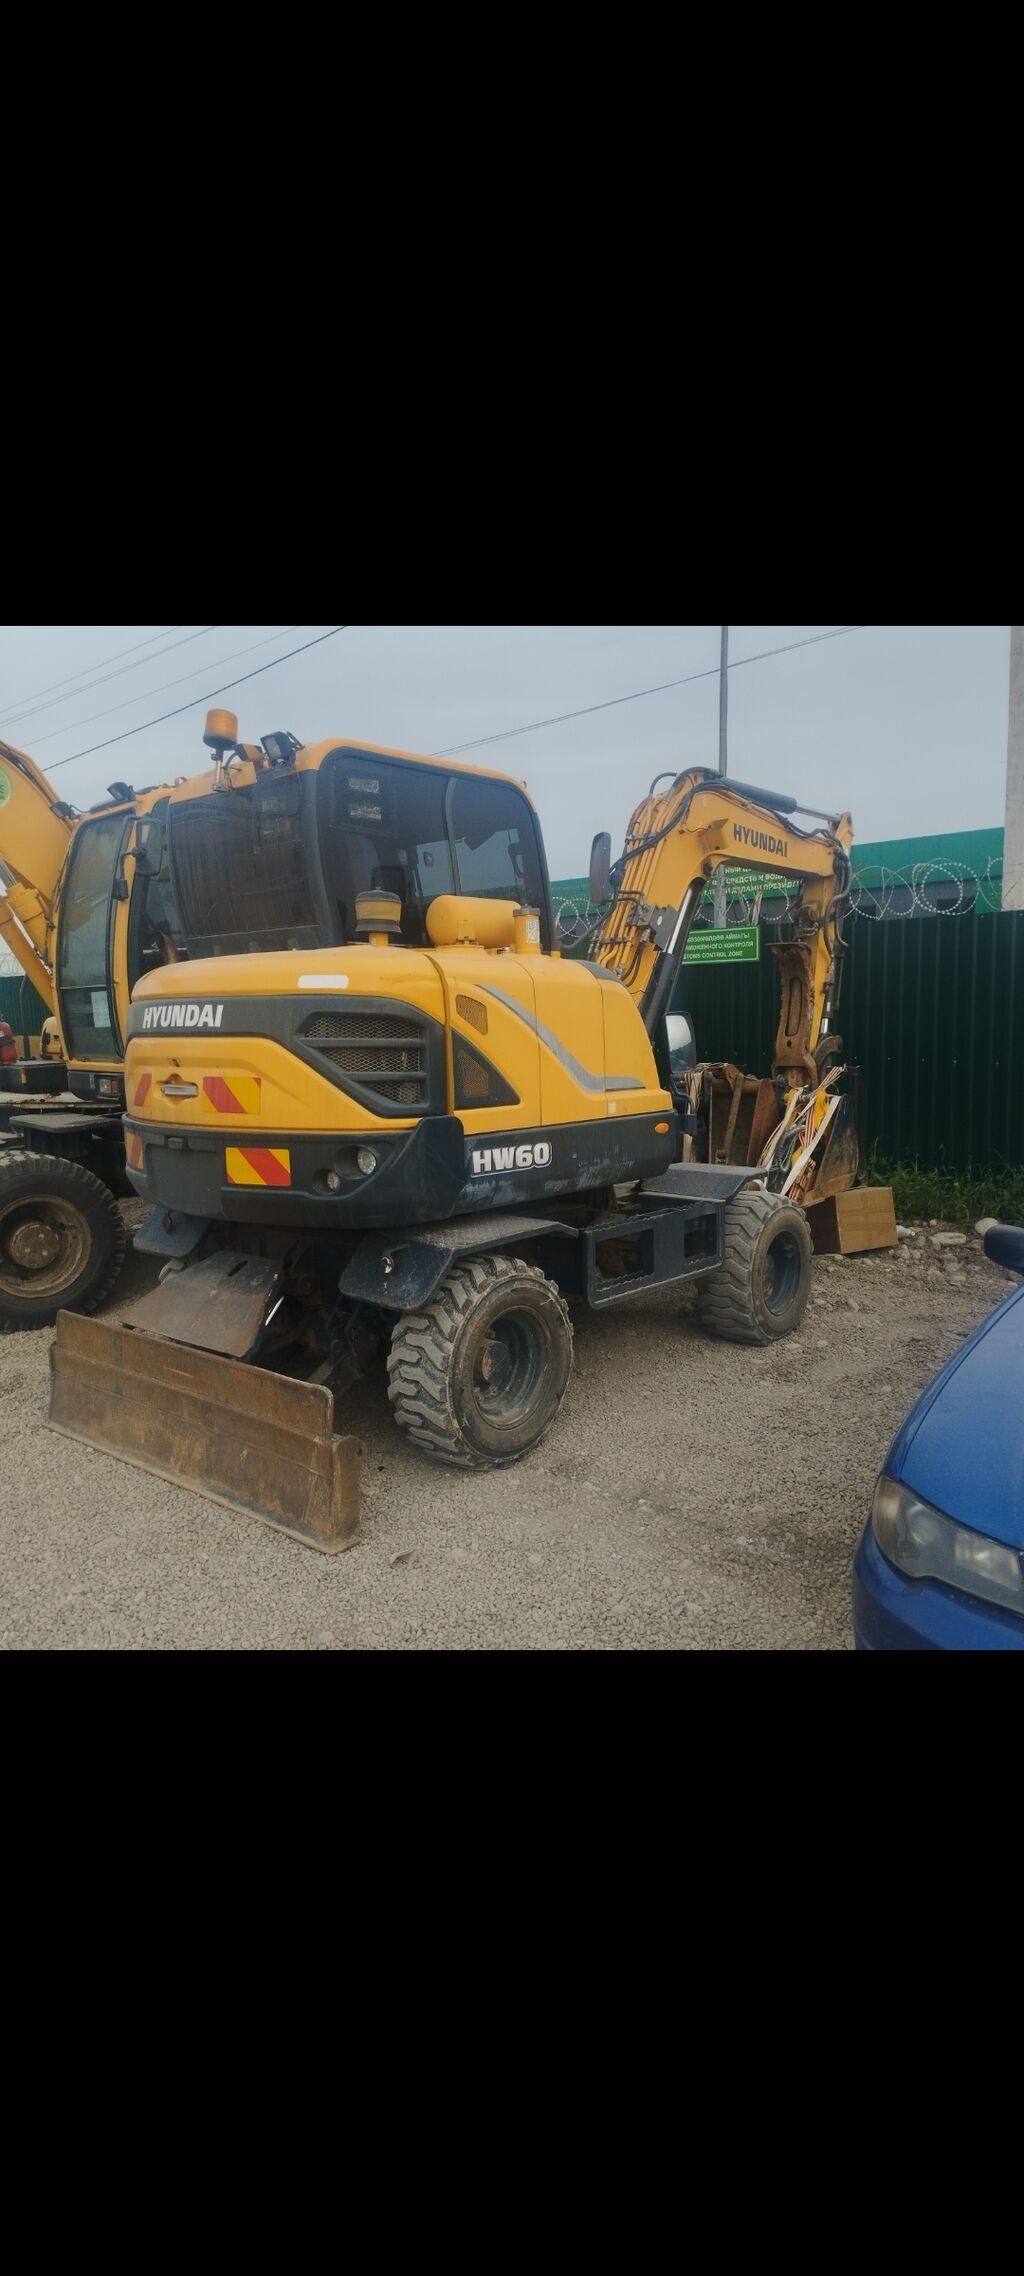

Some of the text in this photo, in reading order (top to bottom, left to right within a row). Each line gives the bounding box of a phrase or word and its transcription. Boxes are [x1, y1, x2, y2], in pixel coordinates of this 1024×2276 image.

[733, 823, 788, 858] HYUNDAI
[142, 1004, 224, 1029] HYUNDAI
[472, 1142, 551, 1175] HW60
